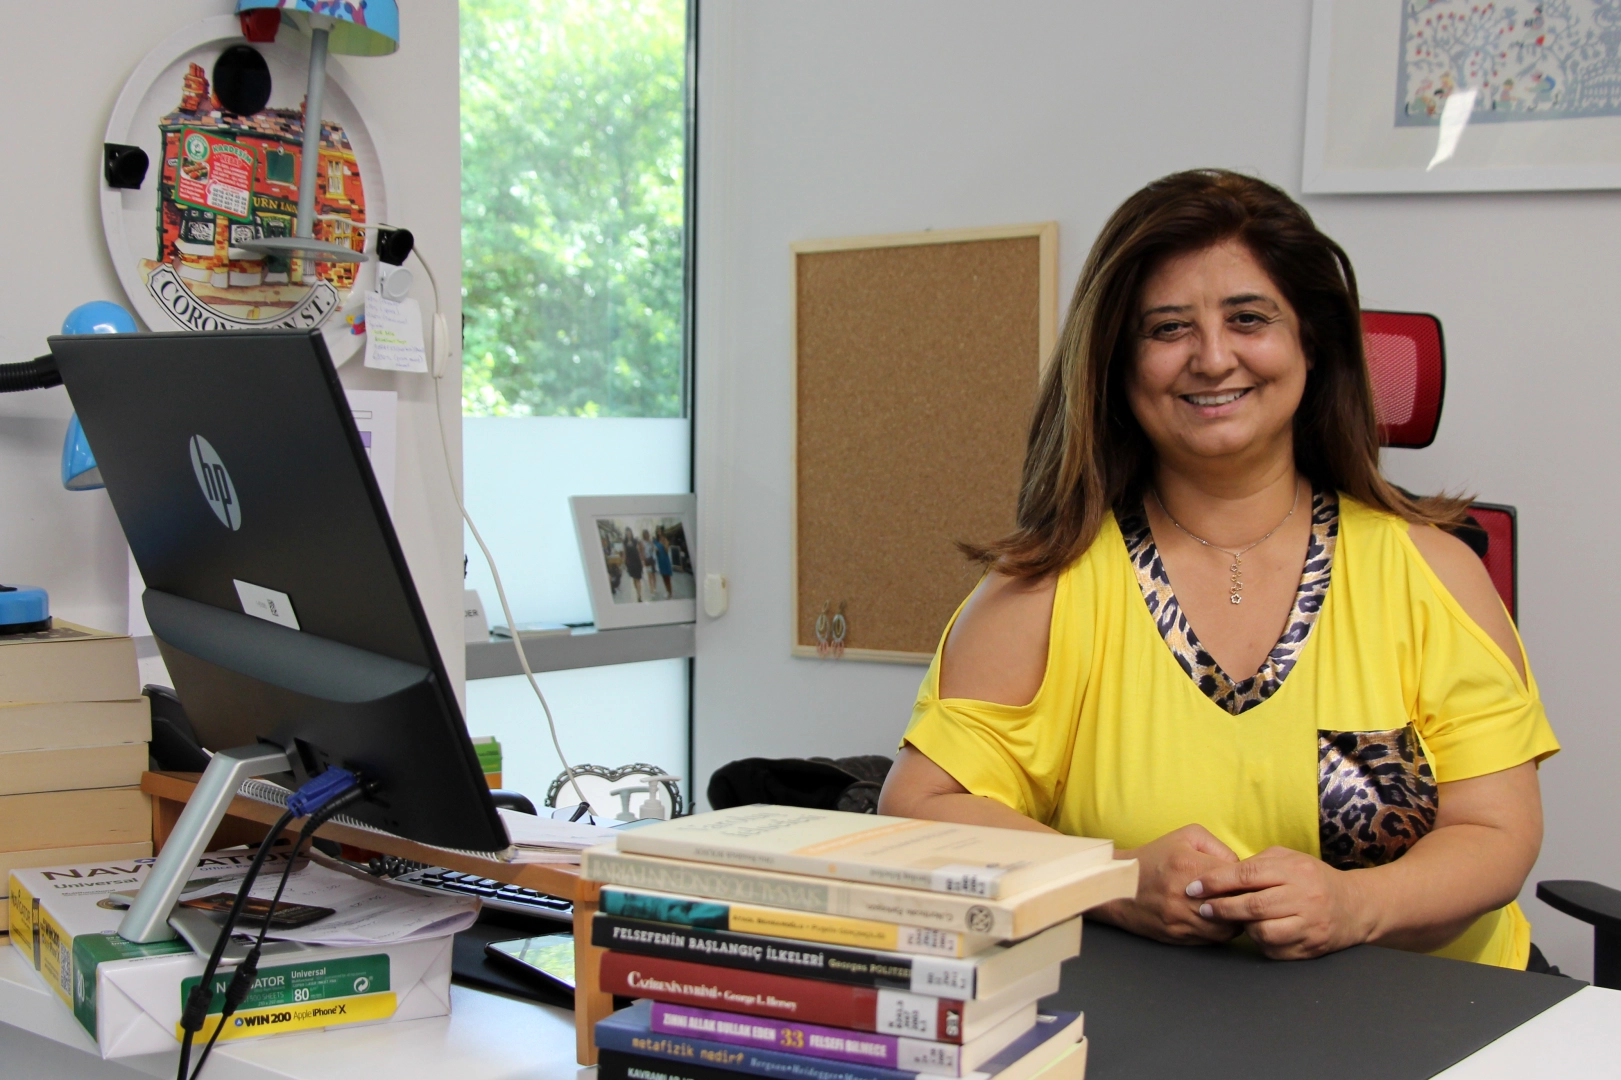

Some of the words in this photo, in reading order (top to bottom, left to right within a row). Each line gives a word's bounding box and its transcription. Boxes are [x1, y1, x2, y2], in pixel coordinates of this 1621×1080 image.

[301, 295, 331, 327] ST.
[53, 877, 139, 890] Universal
[612, 926, 686, 949] FELSEFENİN
[688, 937, 763, 961] BAŞLANGIÇ
[766, 945, 825, 968] İLKELERİ
[828, 957, 868, 974] Georges
[291, 966, 326, 979] Universal
[262, 990, 284, 1000] SHEETS
[294, 987, 310, 1002] 80
[723, 989, 756, 1004] George
[757, 994, 766, 1005] L.
[244, 1014, 270, 1027] WIN
[271, 1012, 292, 1024] 200
[293, 1009, 312, 1020] Apple
[338, 1004, 347, 1015] X
[688, 1016, 716, 1032] ALLAK
[717, 1020, 752, 1037] BULLAK
[752, 1025, 777, 1041] EDEN
[780, 1027, 804, 1048] 33
[632, 1037, 695, 1058] metafizik
[700, 1048, 745, 1065] nedir?
